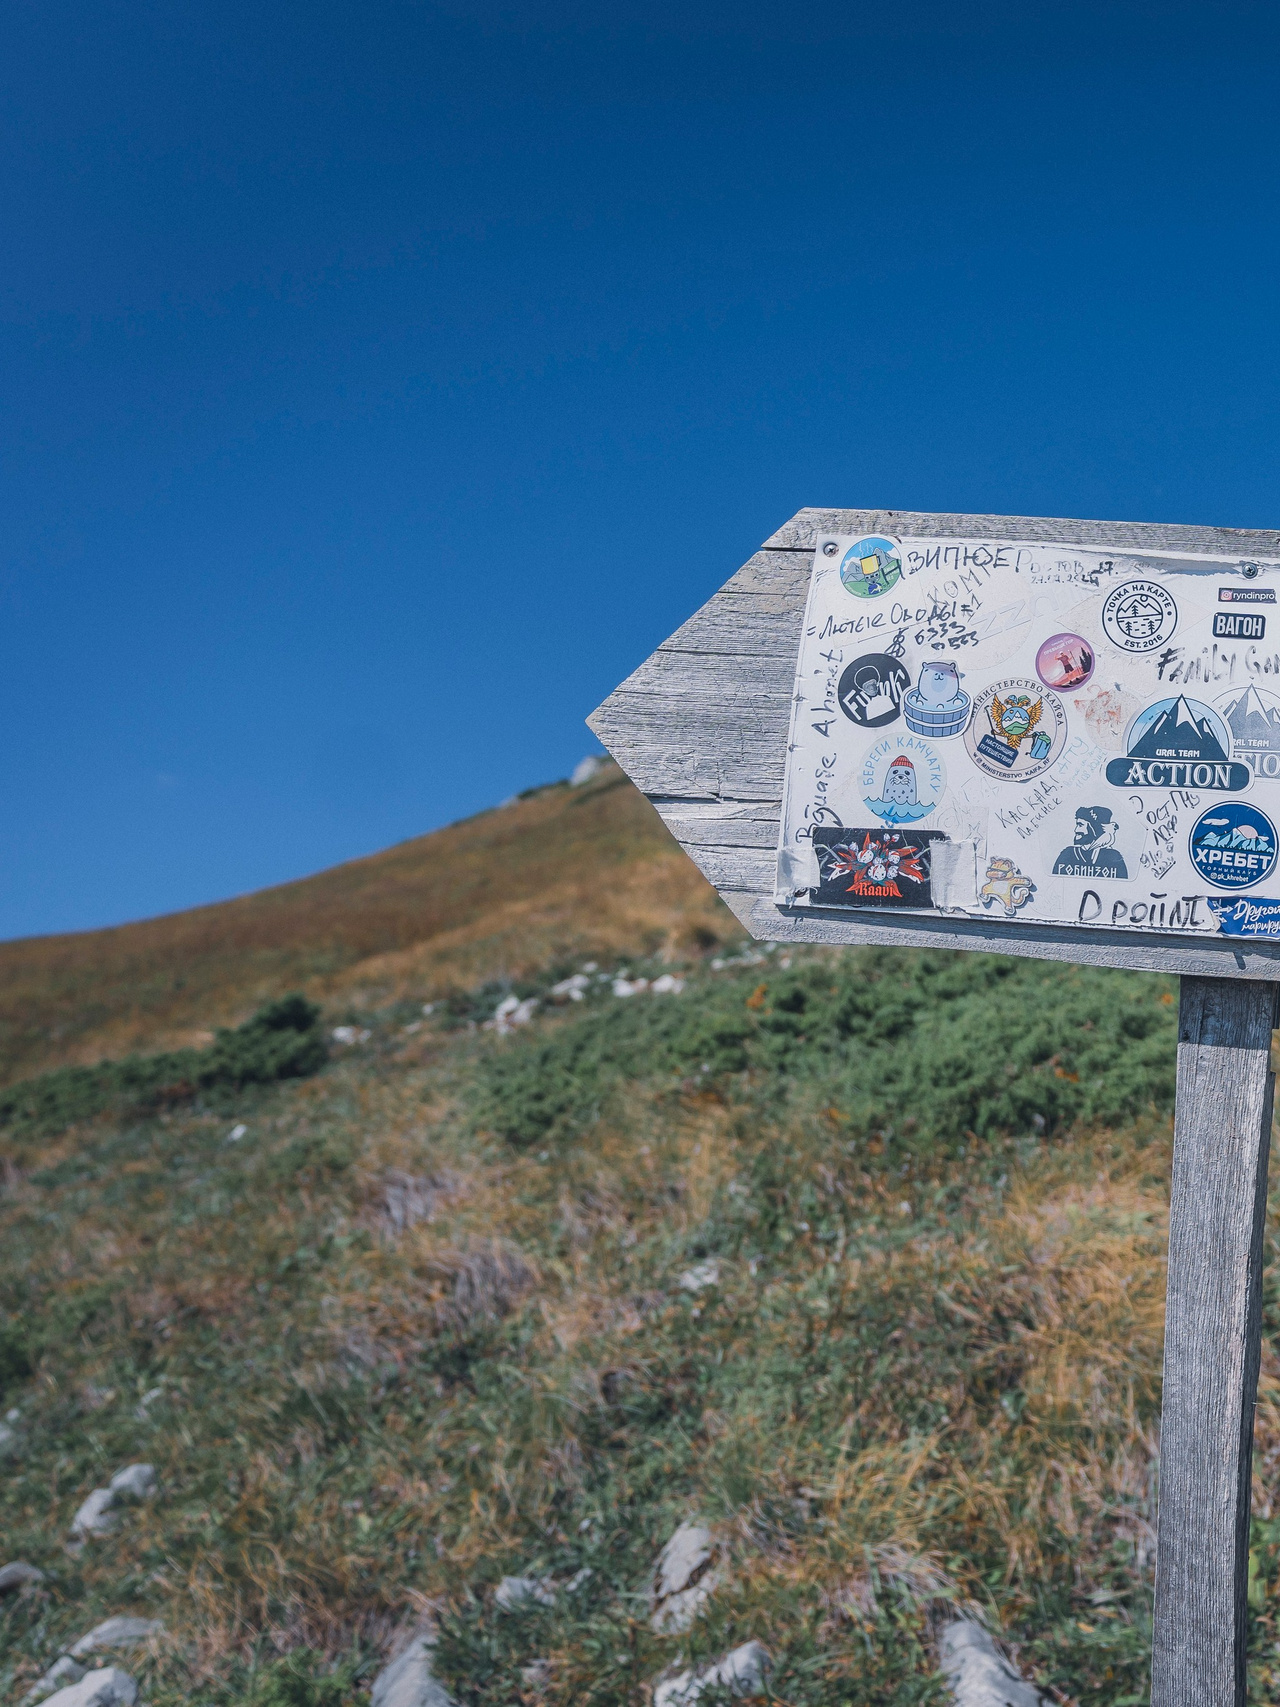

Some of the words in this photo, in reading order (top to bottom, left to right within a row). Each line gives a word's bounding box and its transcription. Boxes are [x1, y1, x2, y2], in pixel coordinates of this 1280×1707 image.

[1106, 587, 1130, 614] ТОЧКА
[1132, 584, 1146, 592] НА
[1147, 586, 1172, 609] КАРТЕ
[1233, 591, 1276, 602] ryndinpro
[1216, 615, 1263, 637] ВАГОН
[1124, 639, 1142, 648] EST.
[1143, 634, 1163, 648] 2016
[1045, 691, 1064, 726] КАЙФА
[1248, 739, 1270, 748] TEAM
[1155, 748, 1177, 757] URAL
[1178, 749, 1200, 758] TEAM
[863, 741, 892, 787] БЕРЕГИ
[896, 736, 942, 793] КАМЧАТКУ
[1124, 761, 1233, 789] ACTION
[1195, 847, 1272, 870] ХРЕБЕТ
[1057, 863, 1118, 879] РОБИНЗОН
[1202, 865, 1234, 874] ГОРНЫЙ
[857, 883, 897, 897] Raavi
